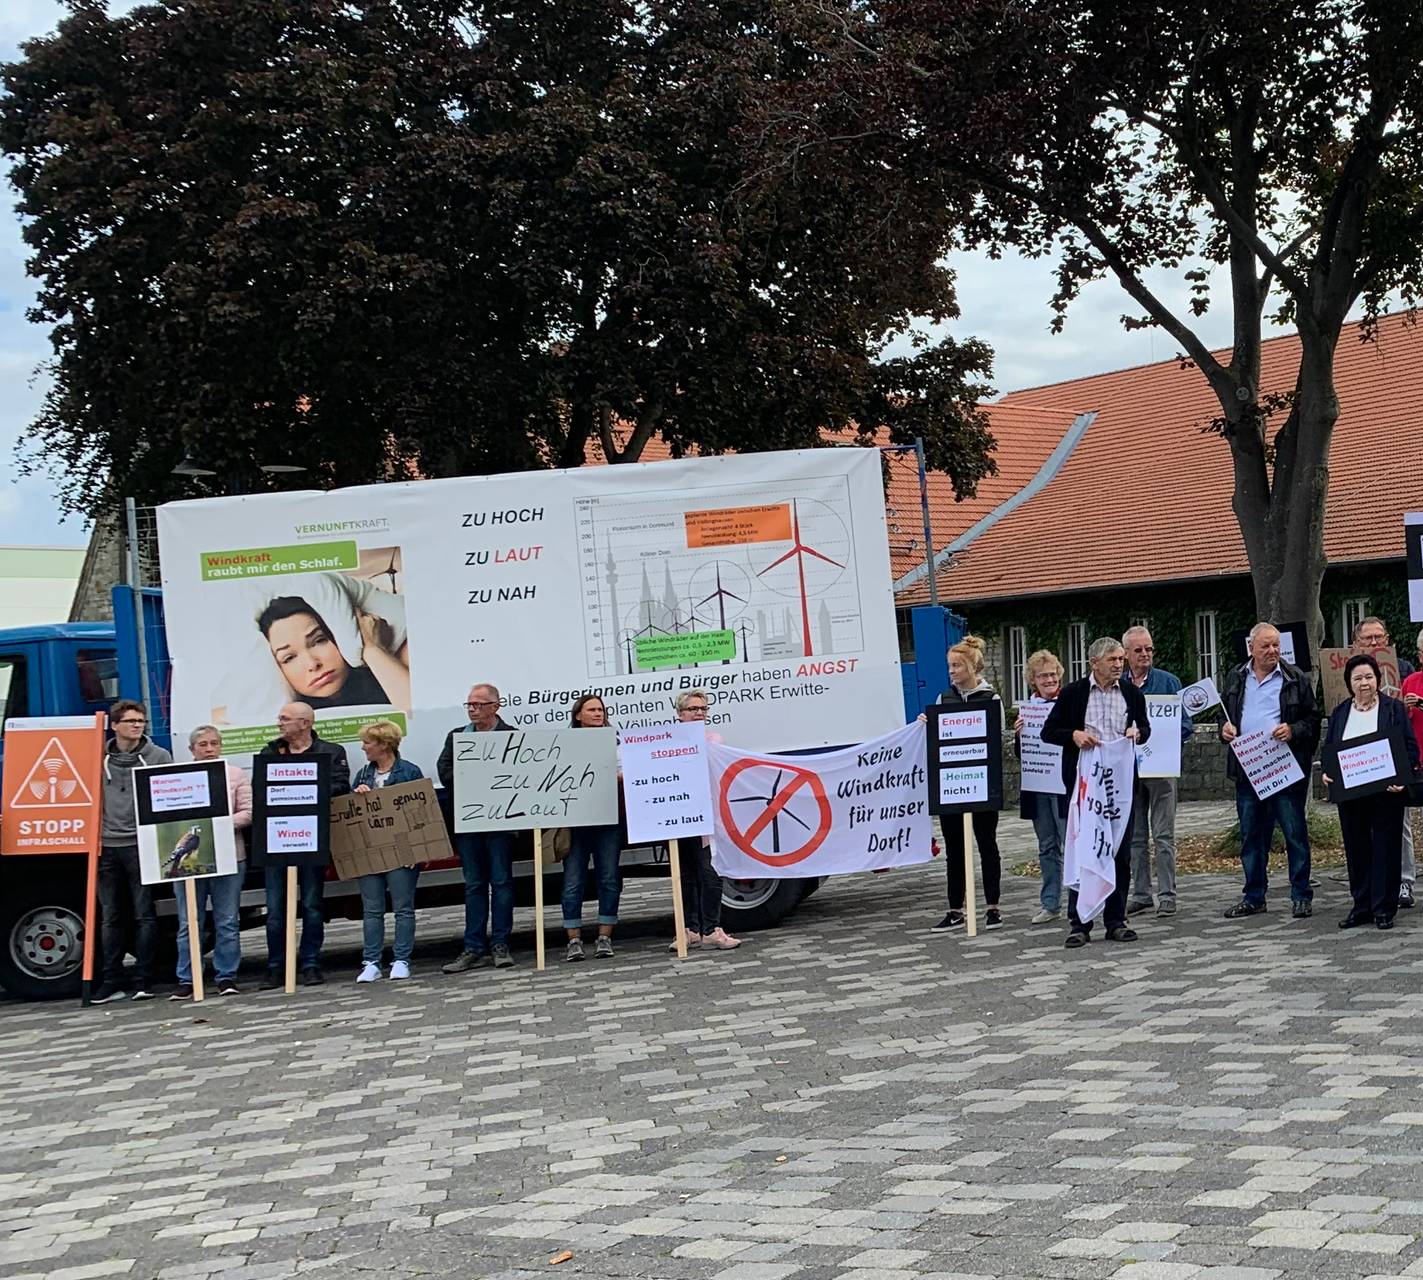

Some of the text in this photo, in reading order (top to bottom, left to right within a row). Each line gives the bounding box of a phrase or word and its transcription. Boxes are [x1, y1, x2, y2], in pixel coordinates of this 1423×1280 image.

[294, 518, 390, 534] VERNUNFTKRAFT.
[462, 507, 544, 527] ZU HOCH
[207, 552, 272, 566] Windkraft
[465, 546, 543, 566] ZU LAUT
[208, 557, 343, 577] raubt mir den Schlaf.
[468, 585, 536, 604] ZU NAH
[642, 677, 674, 693] und
[679, 673, 737, 692] Bürger
[742, 667, 791, 684] haben
[796, 659, 859, 678] ANGST
[514, 683, 830, 726] vor planten Erwitte-
[942, 716, 982, 727] Energie
[624, 732, 673, 745] Windpark
[1232, 731, 1264, 749] Kranker
[501, 733, 562, 765] Hoch
[650, 745, 699, 759] stoppen!
[857, 746, 903, 768] Keine
[942, 747, 985, 756] erneuerbar
[1237, 740, 1268, 758] Mensch
[1242, 744, 1280, 768] totes Tier
[1248, 752, 1291, 778] das machen
[1342, 757, 1378, 770] Windkraft
[537, 762, 595, 793] Nah
[651, 773, 680, 785] hoch
[837, 764, 924, 799] Windkraft
[1252, 762, 1292, 786] Windräder
[943, 786, 970, 795] nicht
[1258, 779, 1284, 796] mit Dir
[393, 791, 427, 811] genug
[652, 792, 690, 804] zu nah
[664, 814, 704, 827] zu laut
[849, 801, 924, 829] für unser
[19, 819, 85, 835] STOPP
[277, 830, 312, 838] Winde
[17, 836, 86, 847] INFRASCHALL
[867, 827, 911, 853] Dorf!
